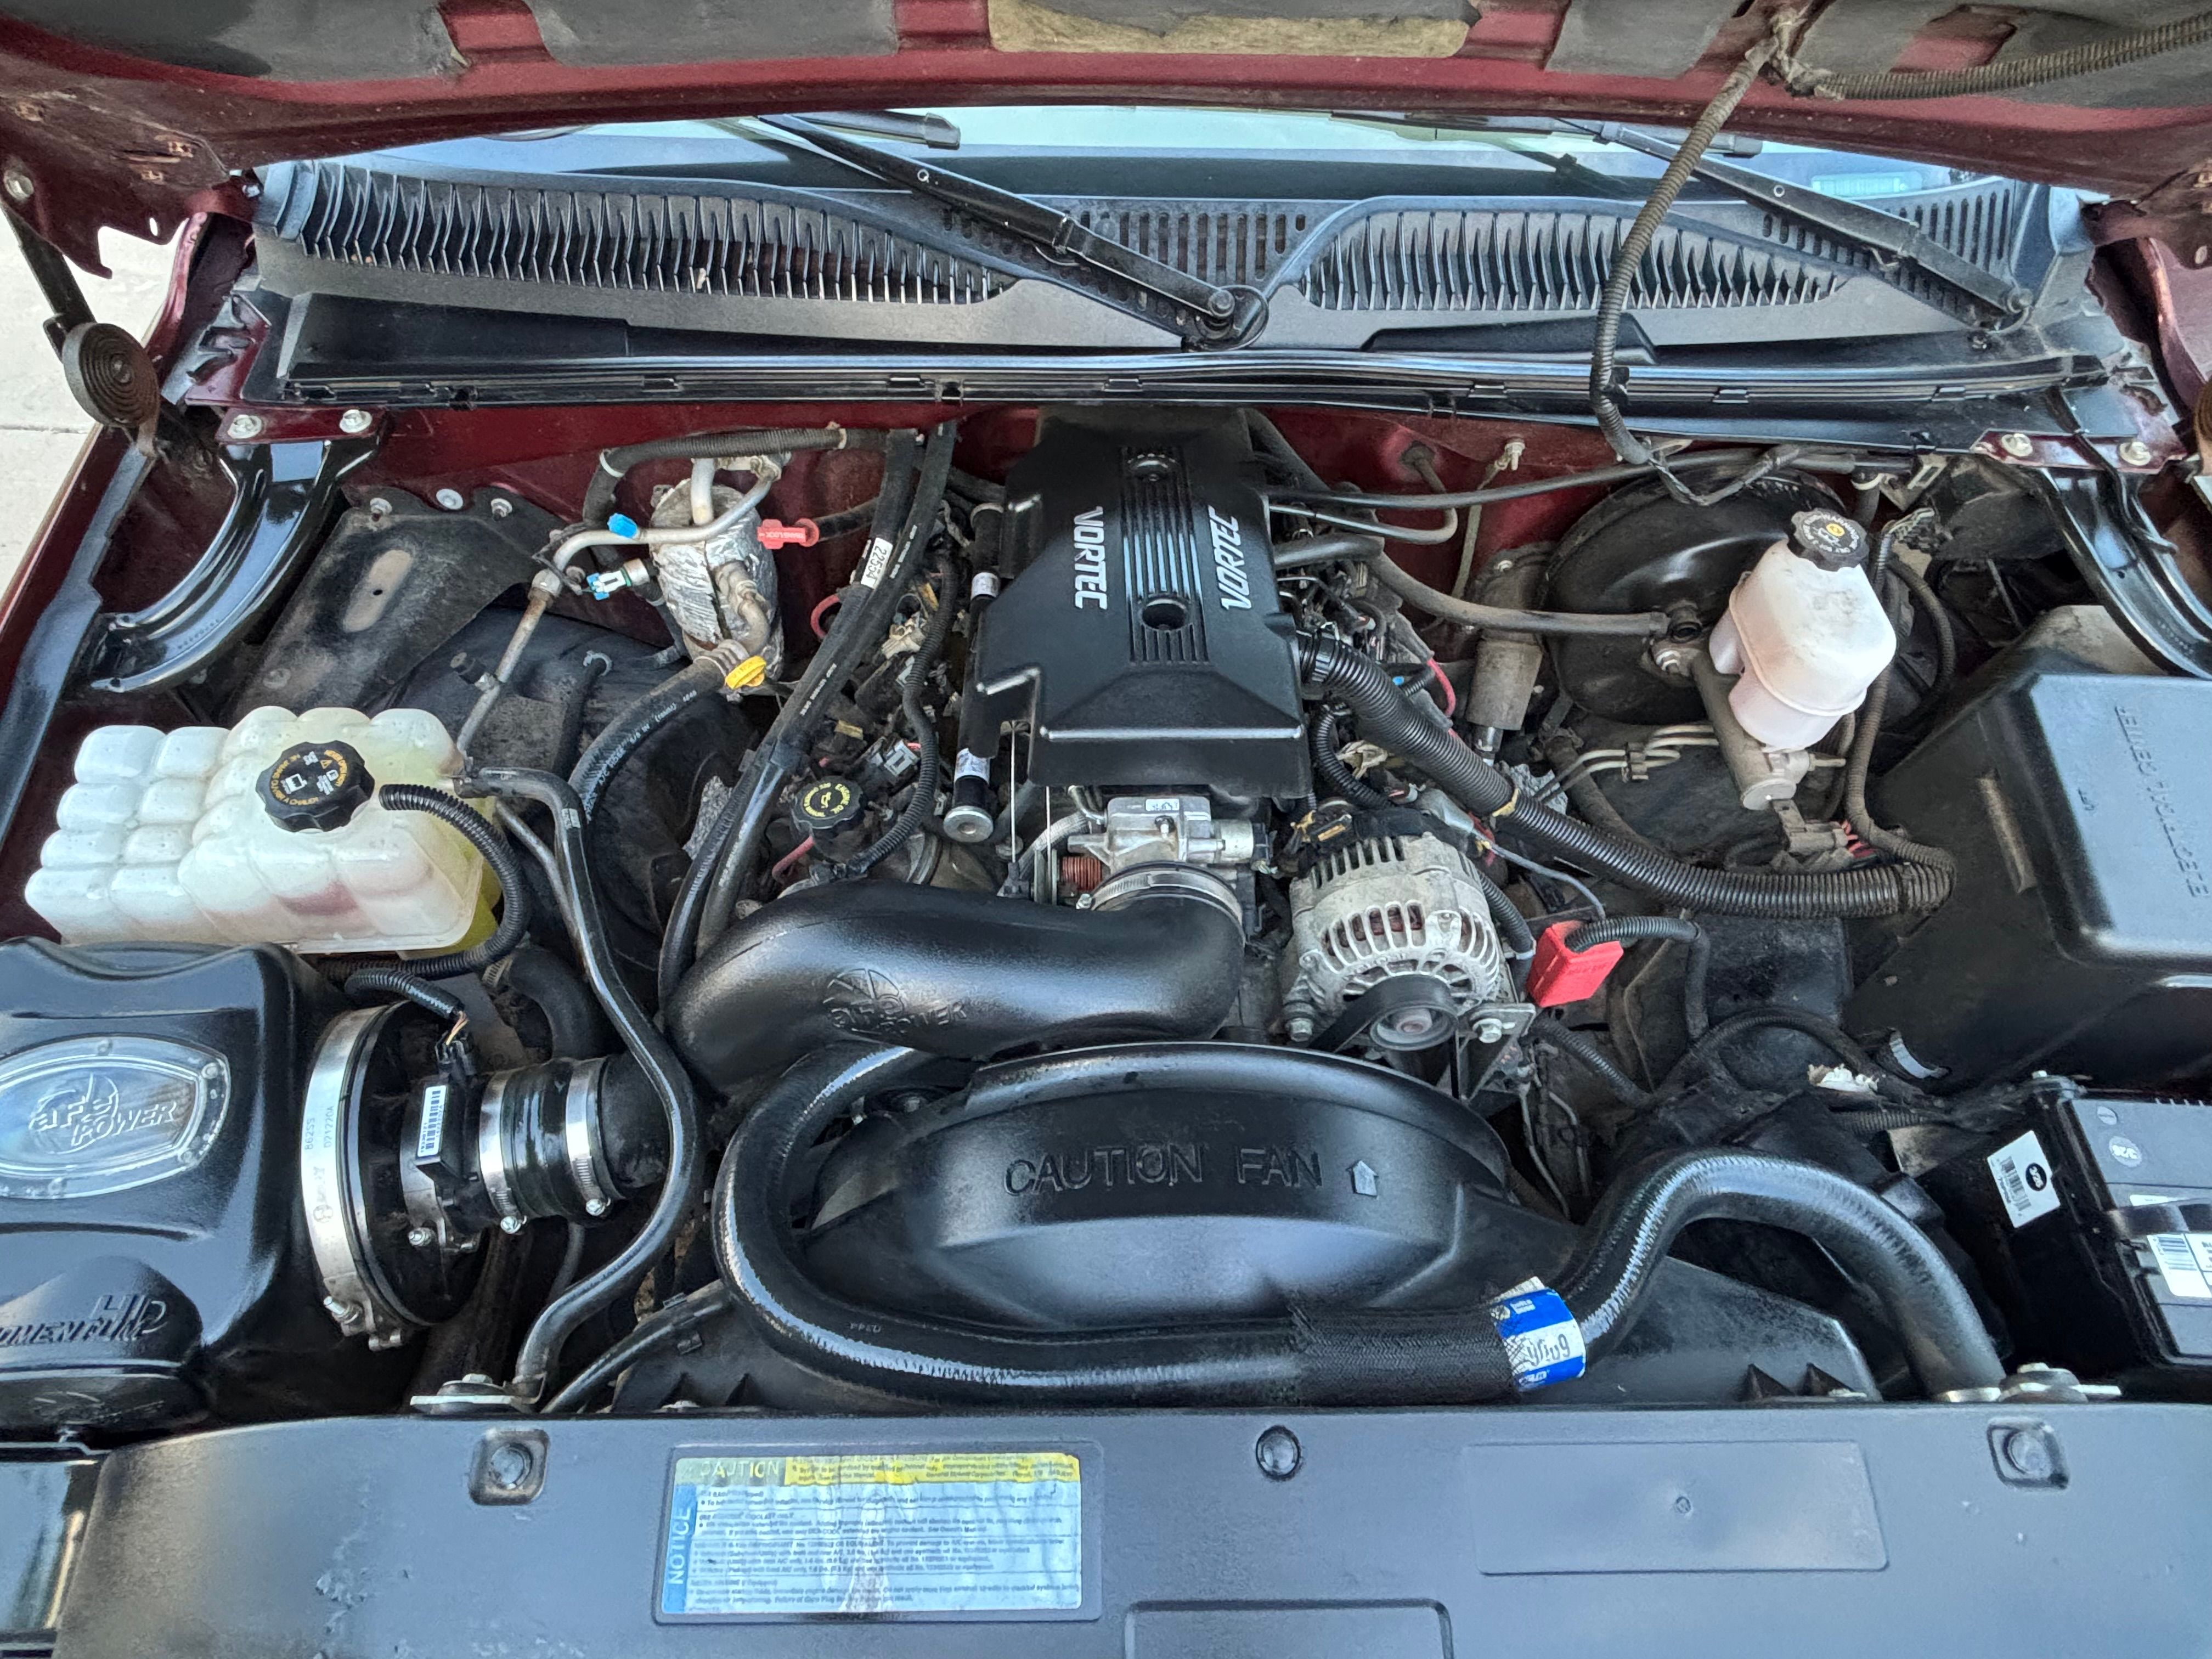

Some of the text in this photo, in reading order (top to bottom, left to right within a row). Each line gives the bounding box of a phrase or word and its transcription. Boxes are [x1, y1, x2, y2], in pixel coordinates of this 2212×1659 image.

[867, 543, 888, 580] 22554
[1074, 506, 1108, 610] VORTEC
[1209, 505, 1252, 610] VORTEC
[1005, 1143, 1324, 1195] CAUTION FAN
[89, 1294, 168, 1334] HD
[700, 1460, 779, 1478] CAUTION
[669, 1506, 691, 1584] NOTICE
